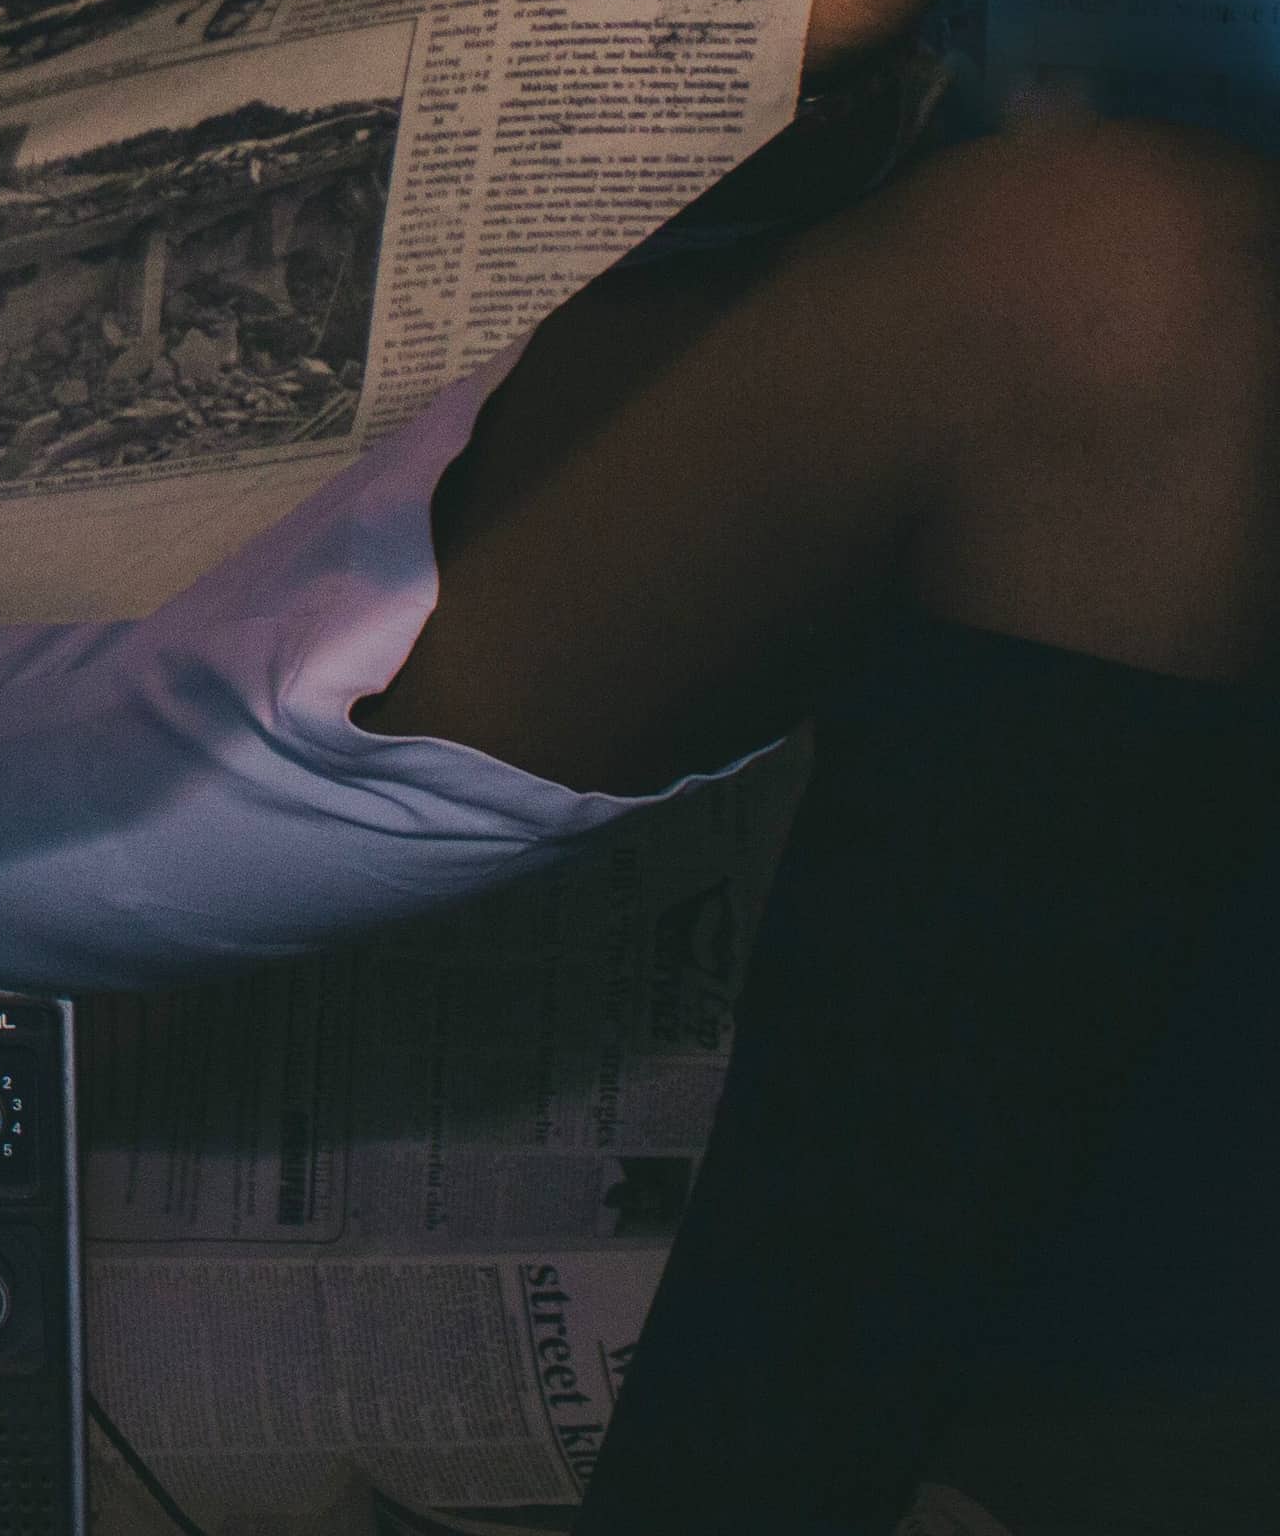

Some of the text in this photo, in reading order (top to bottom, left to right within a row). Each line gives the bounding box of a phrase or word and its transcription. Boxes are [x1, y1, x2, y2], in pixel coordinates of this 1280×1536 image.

[1, 1075, 13, 1090] 2
[11, 1098, 23, 1111] 3
[11, 1121, 23, 1136] 4
[3, 1143, 13, 1157] 5
[525, 1264, 589, 1407] street
